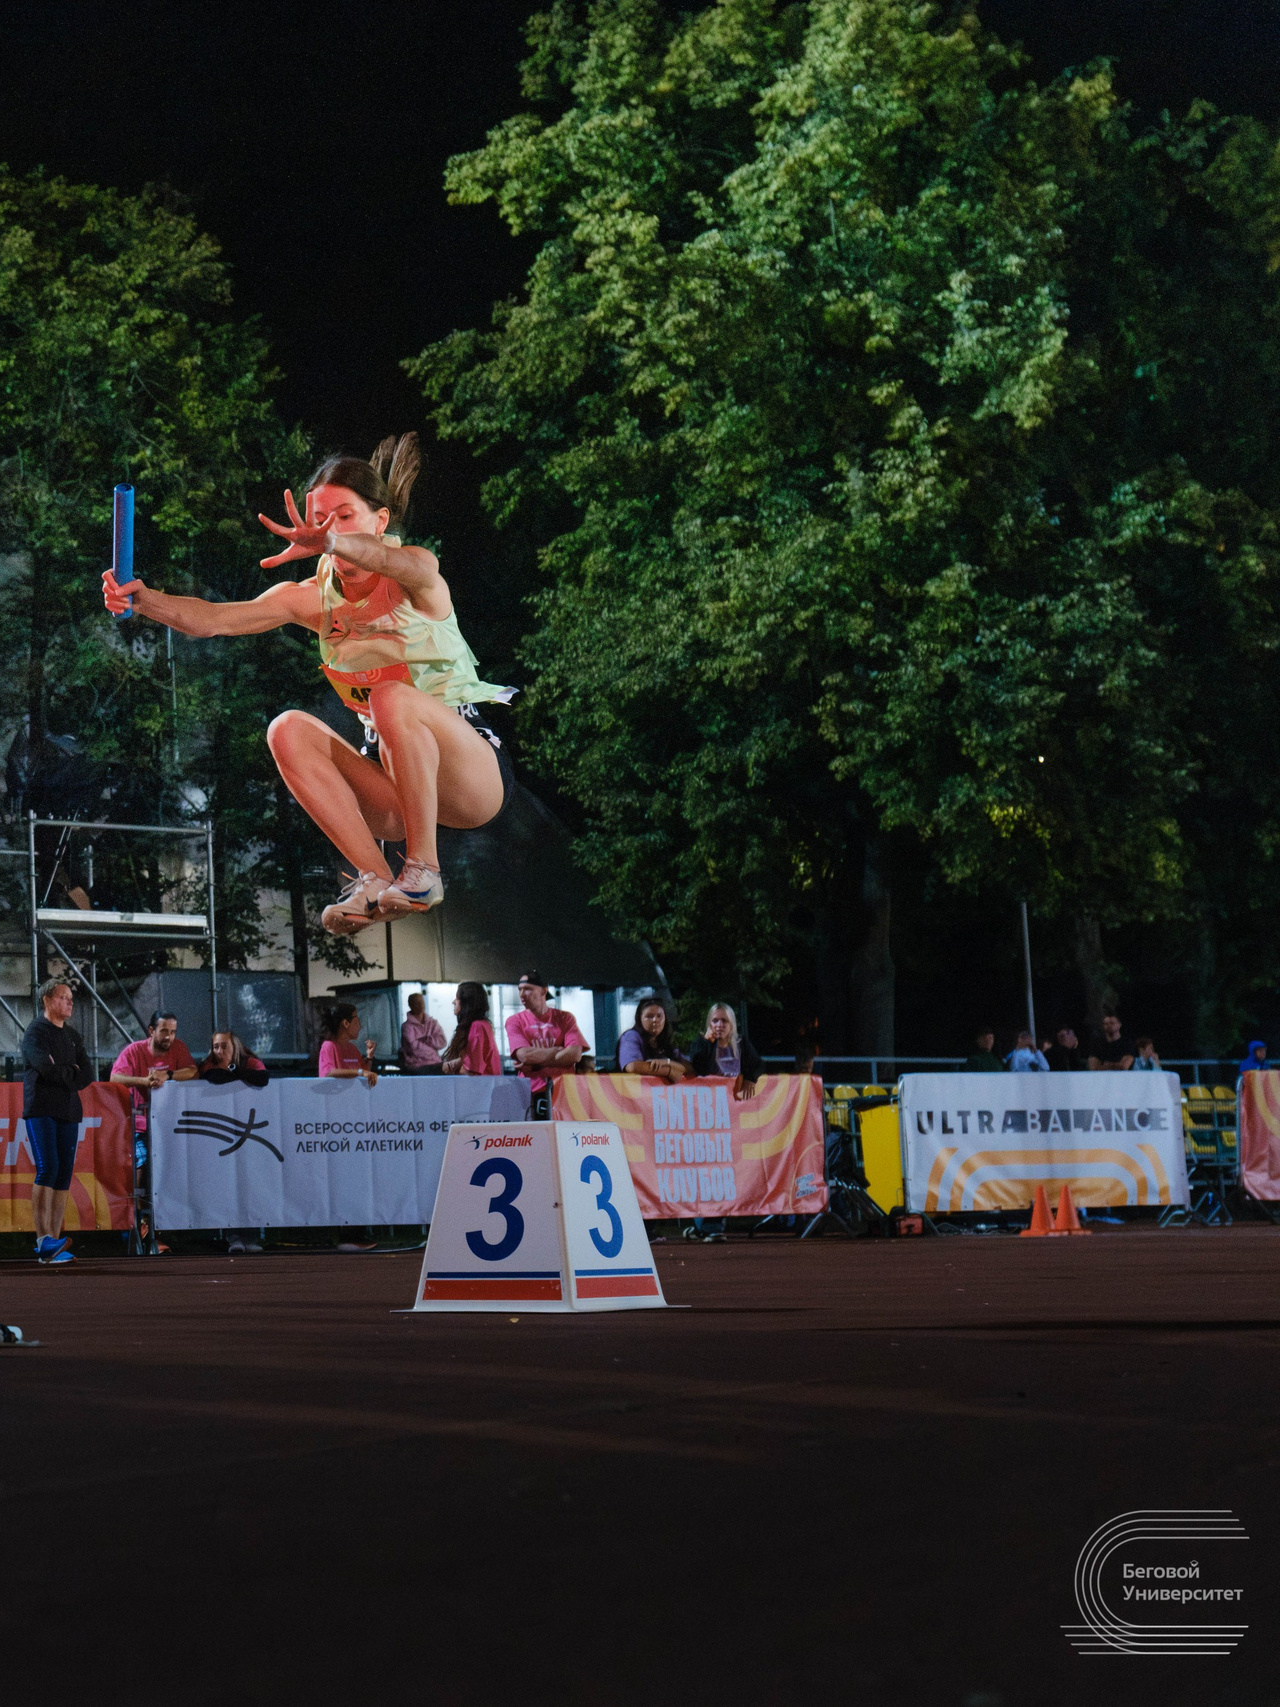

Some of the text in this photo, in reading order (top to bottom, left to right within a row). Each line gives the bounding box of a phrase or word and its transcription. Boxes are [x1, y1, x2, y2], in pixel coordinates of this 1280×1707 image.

[651, 1085, 731, 1130] БИТВА
[295, 1119, 425, 1135] ВСЕРОССИЙСКАЯ
[484, 1134, 533, 1151] polanik
[581, 1133, 610, 1148] polanik
[296, 1138, 423, 1153] ЛЕГКОЙ АТЛЕТИКИ
[654, 1132, 733, 1164] БЕГОВЫХ
[656, 1167, 737, 1203] КЛУБОВ
[465, 1157, 525, 1262] 3
[580, 1155, 624, 1258] 3
